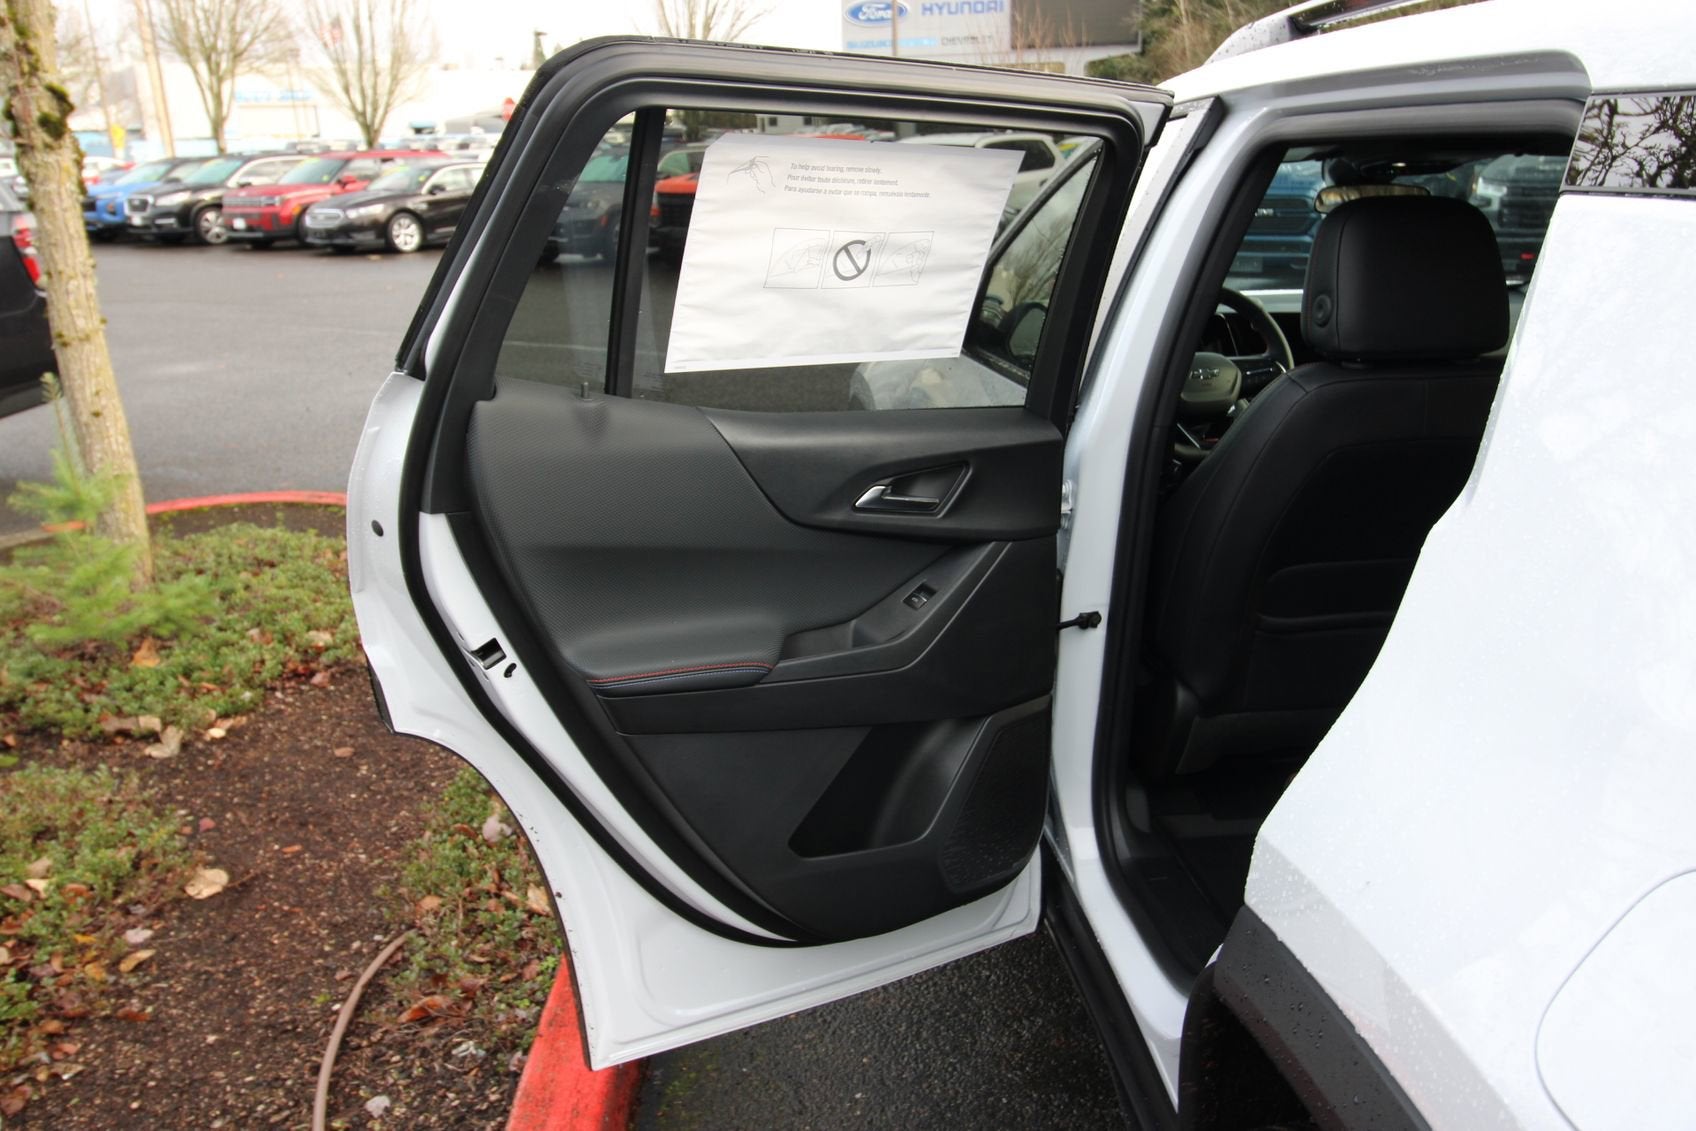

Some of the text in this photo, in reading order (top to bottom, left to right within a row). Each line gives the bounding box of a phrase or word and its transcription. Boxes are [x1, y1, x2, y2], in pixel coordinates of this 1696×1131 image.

[921, 0, 1005, 16] HYUNDAI
[798, 163, 810, 171] help
[784, 184, 797, 192] Para
